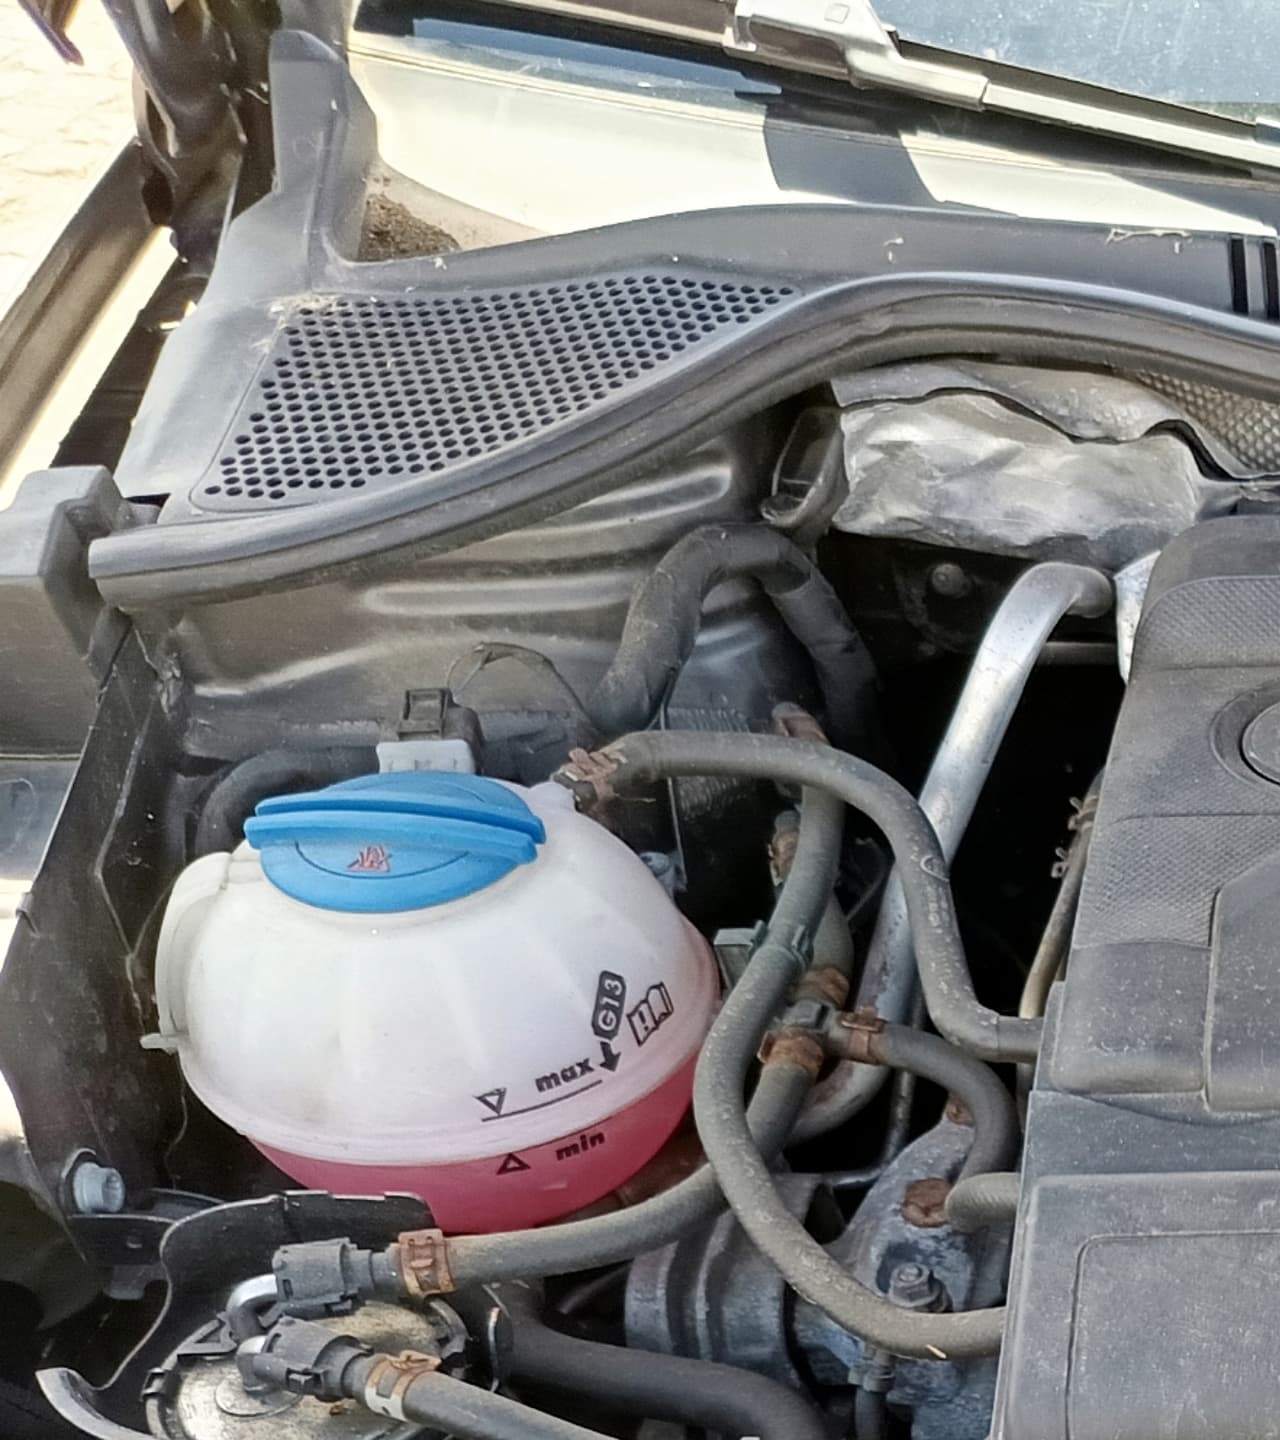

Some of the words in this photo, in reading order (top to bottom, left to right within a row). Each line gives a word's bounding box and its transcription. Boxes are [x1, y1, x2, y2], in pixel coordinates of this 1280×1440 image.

[598, 977, 622, 1031] G13
[535, 1057, 595, 1092] max
[555, 1132, 605, 1161] min
